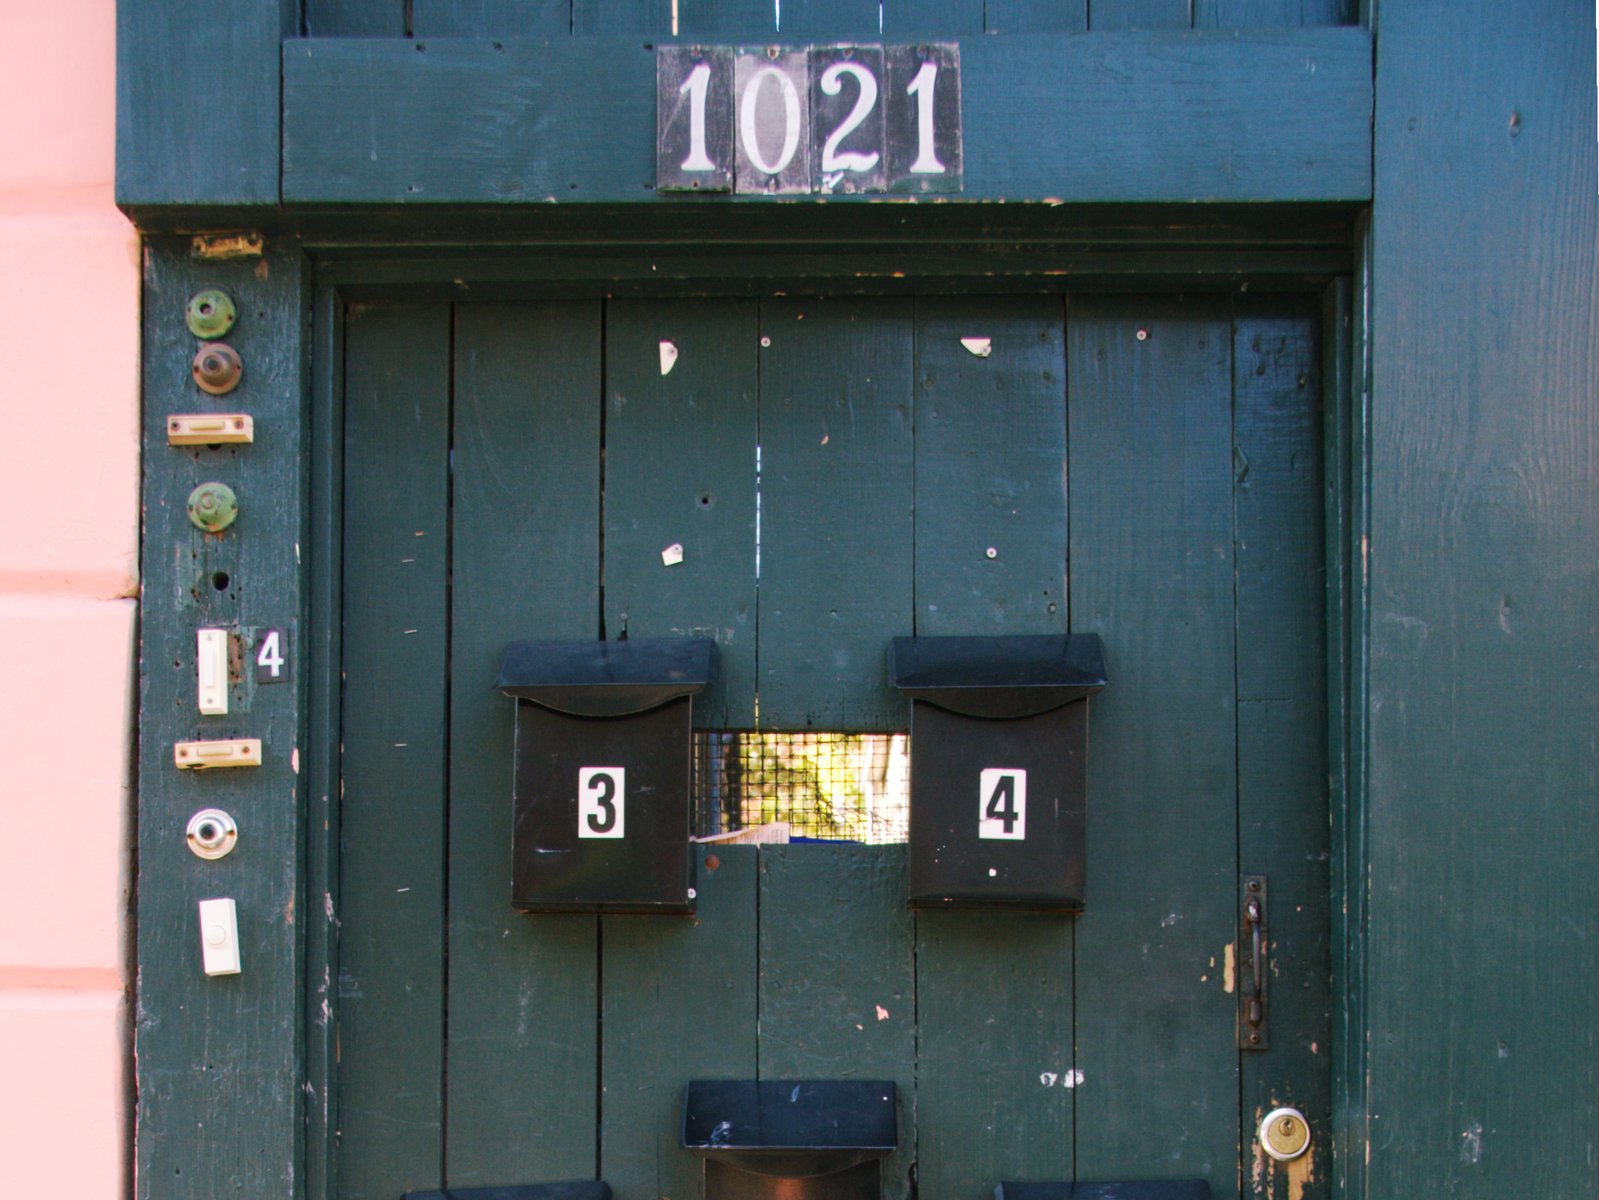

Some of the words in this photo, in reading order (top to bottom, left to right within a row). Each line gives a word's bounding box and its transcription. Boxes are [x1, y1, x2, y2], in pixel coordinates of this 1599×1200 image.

[680, 62, 946, 174] 1021
[258, 631, 284, 677] 4
[587, 773, 616, 834] 3
[986, 775, 1019, 834] 4
